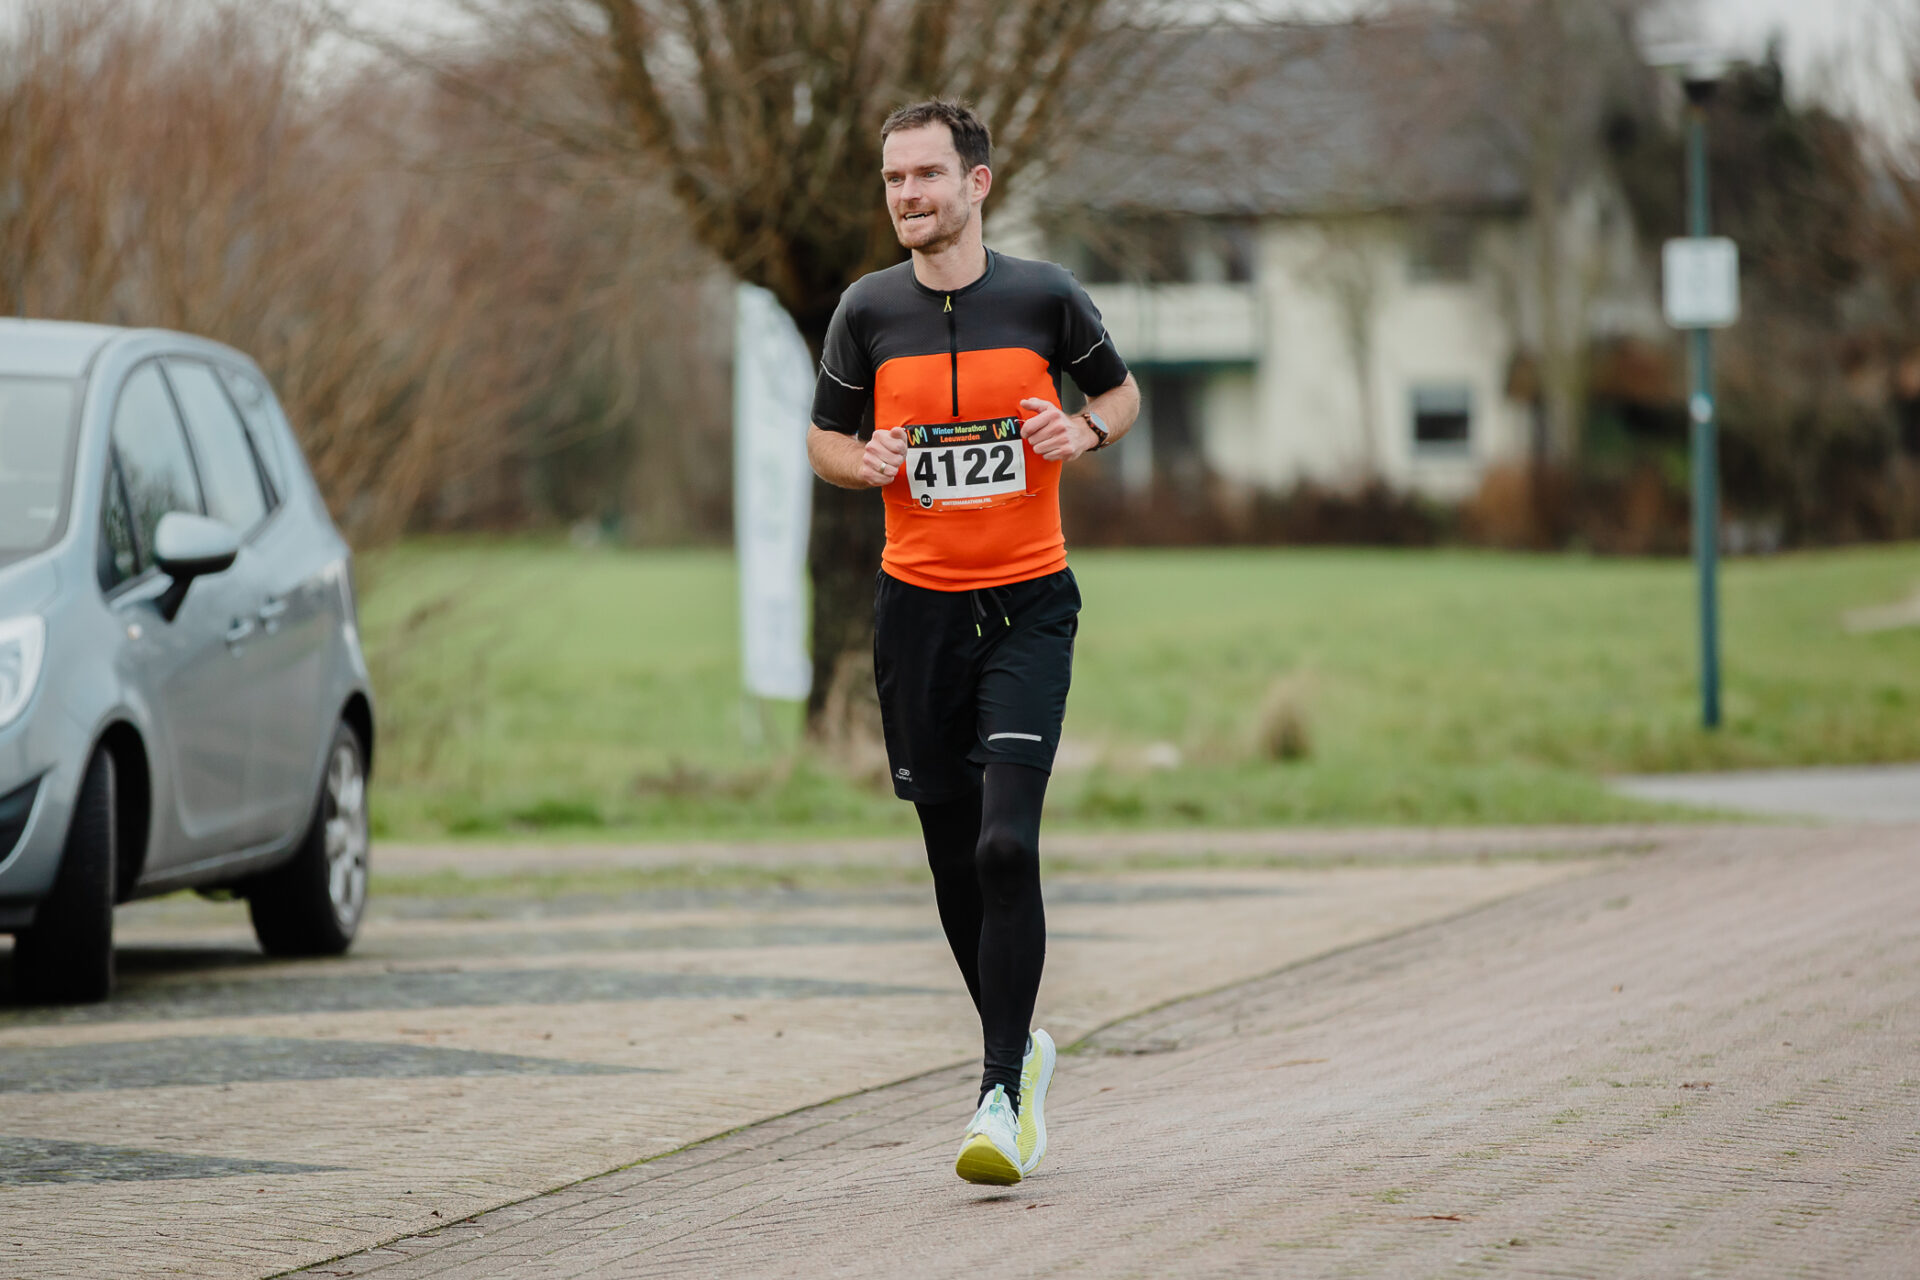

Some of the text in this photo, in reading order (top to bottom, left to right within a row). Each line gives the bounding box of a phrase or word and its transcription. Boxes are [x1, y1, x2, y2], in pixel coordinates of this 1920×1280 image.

[932, 425, 987, 435] Winter Marathon
[940, 434, 980, 443] Leeuwarden
[914, 445, 1015, 487] 4122
